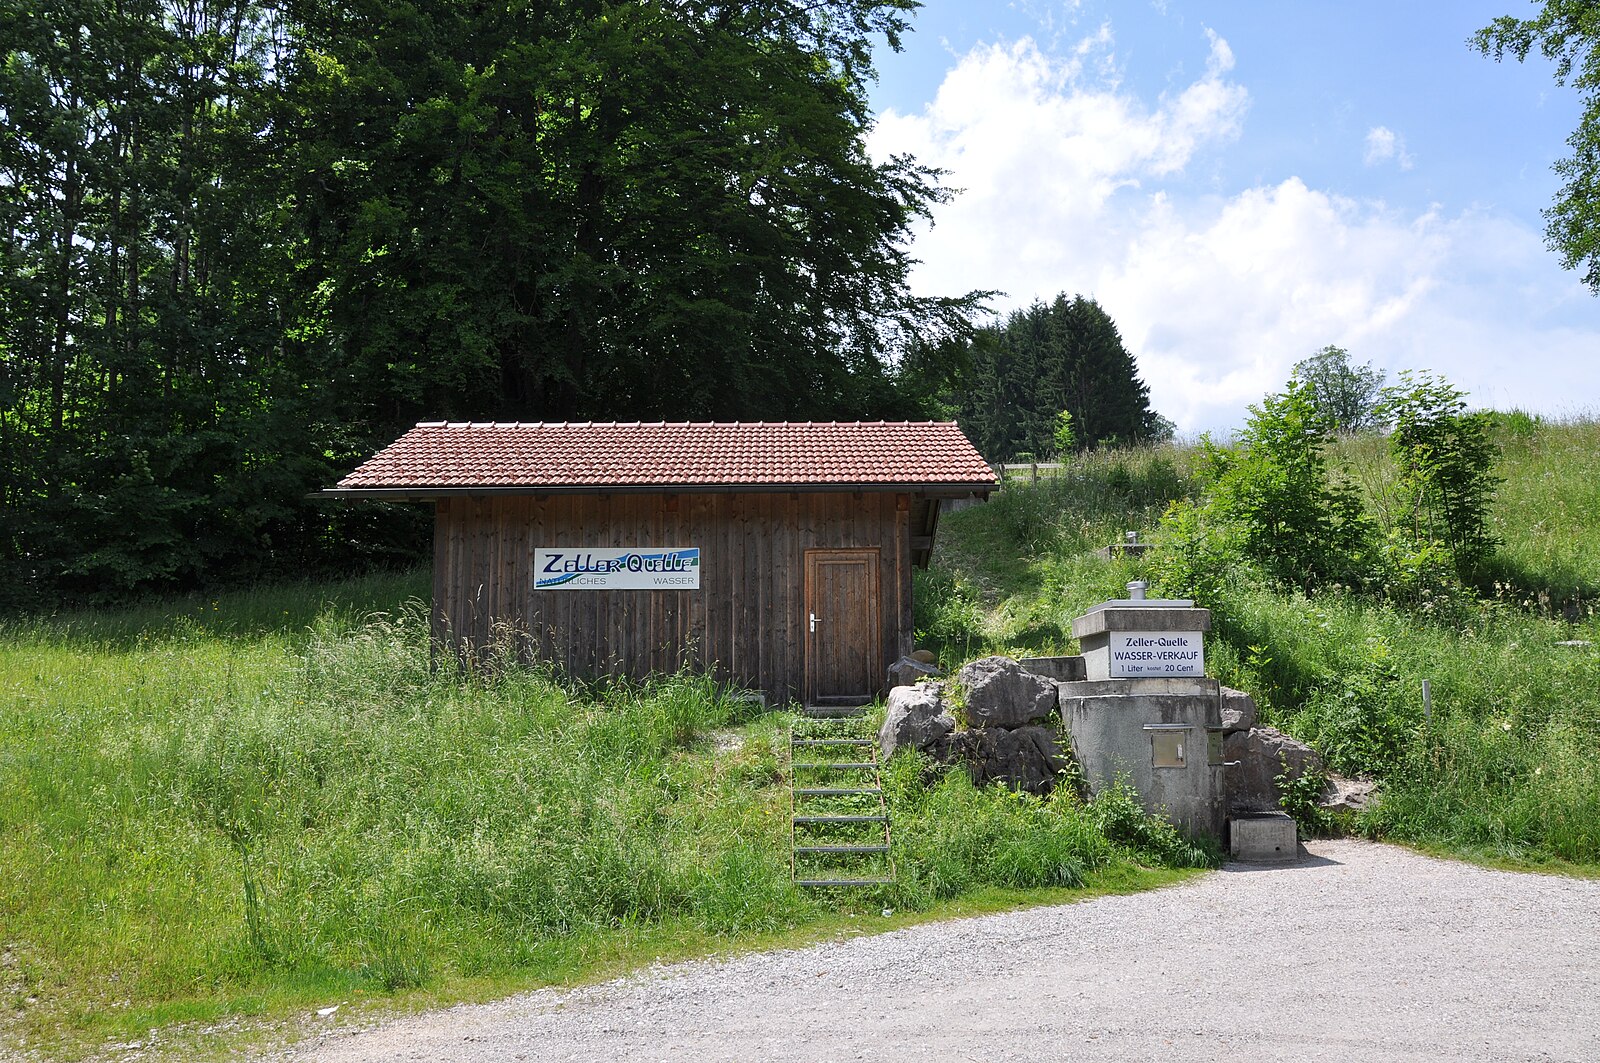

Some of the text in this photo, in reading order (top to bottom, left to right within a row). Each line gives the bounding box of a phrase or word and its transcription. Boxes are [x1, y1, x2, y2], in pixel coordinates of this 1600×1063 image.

[653, 577, 694, 585] WASSER
[1126, 638, 1188, 647] Zeller-Quelle
[1114, 651, 1198, 661] WASSER-VERKAUF
[1164, 664, 1175, 672] 20
[1176, 664, 1194, 672] Cent
